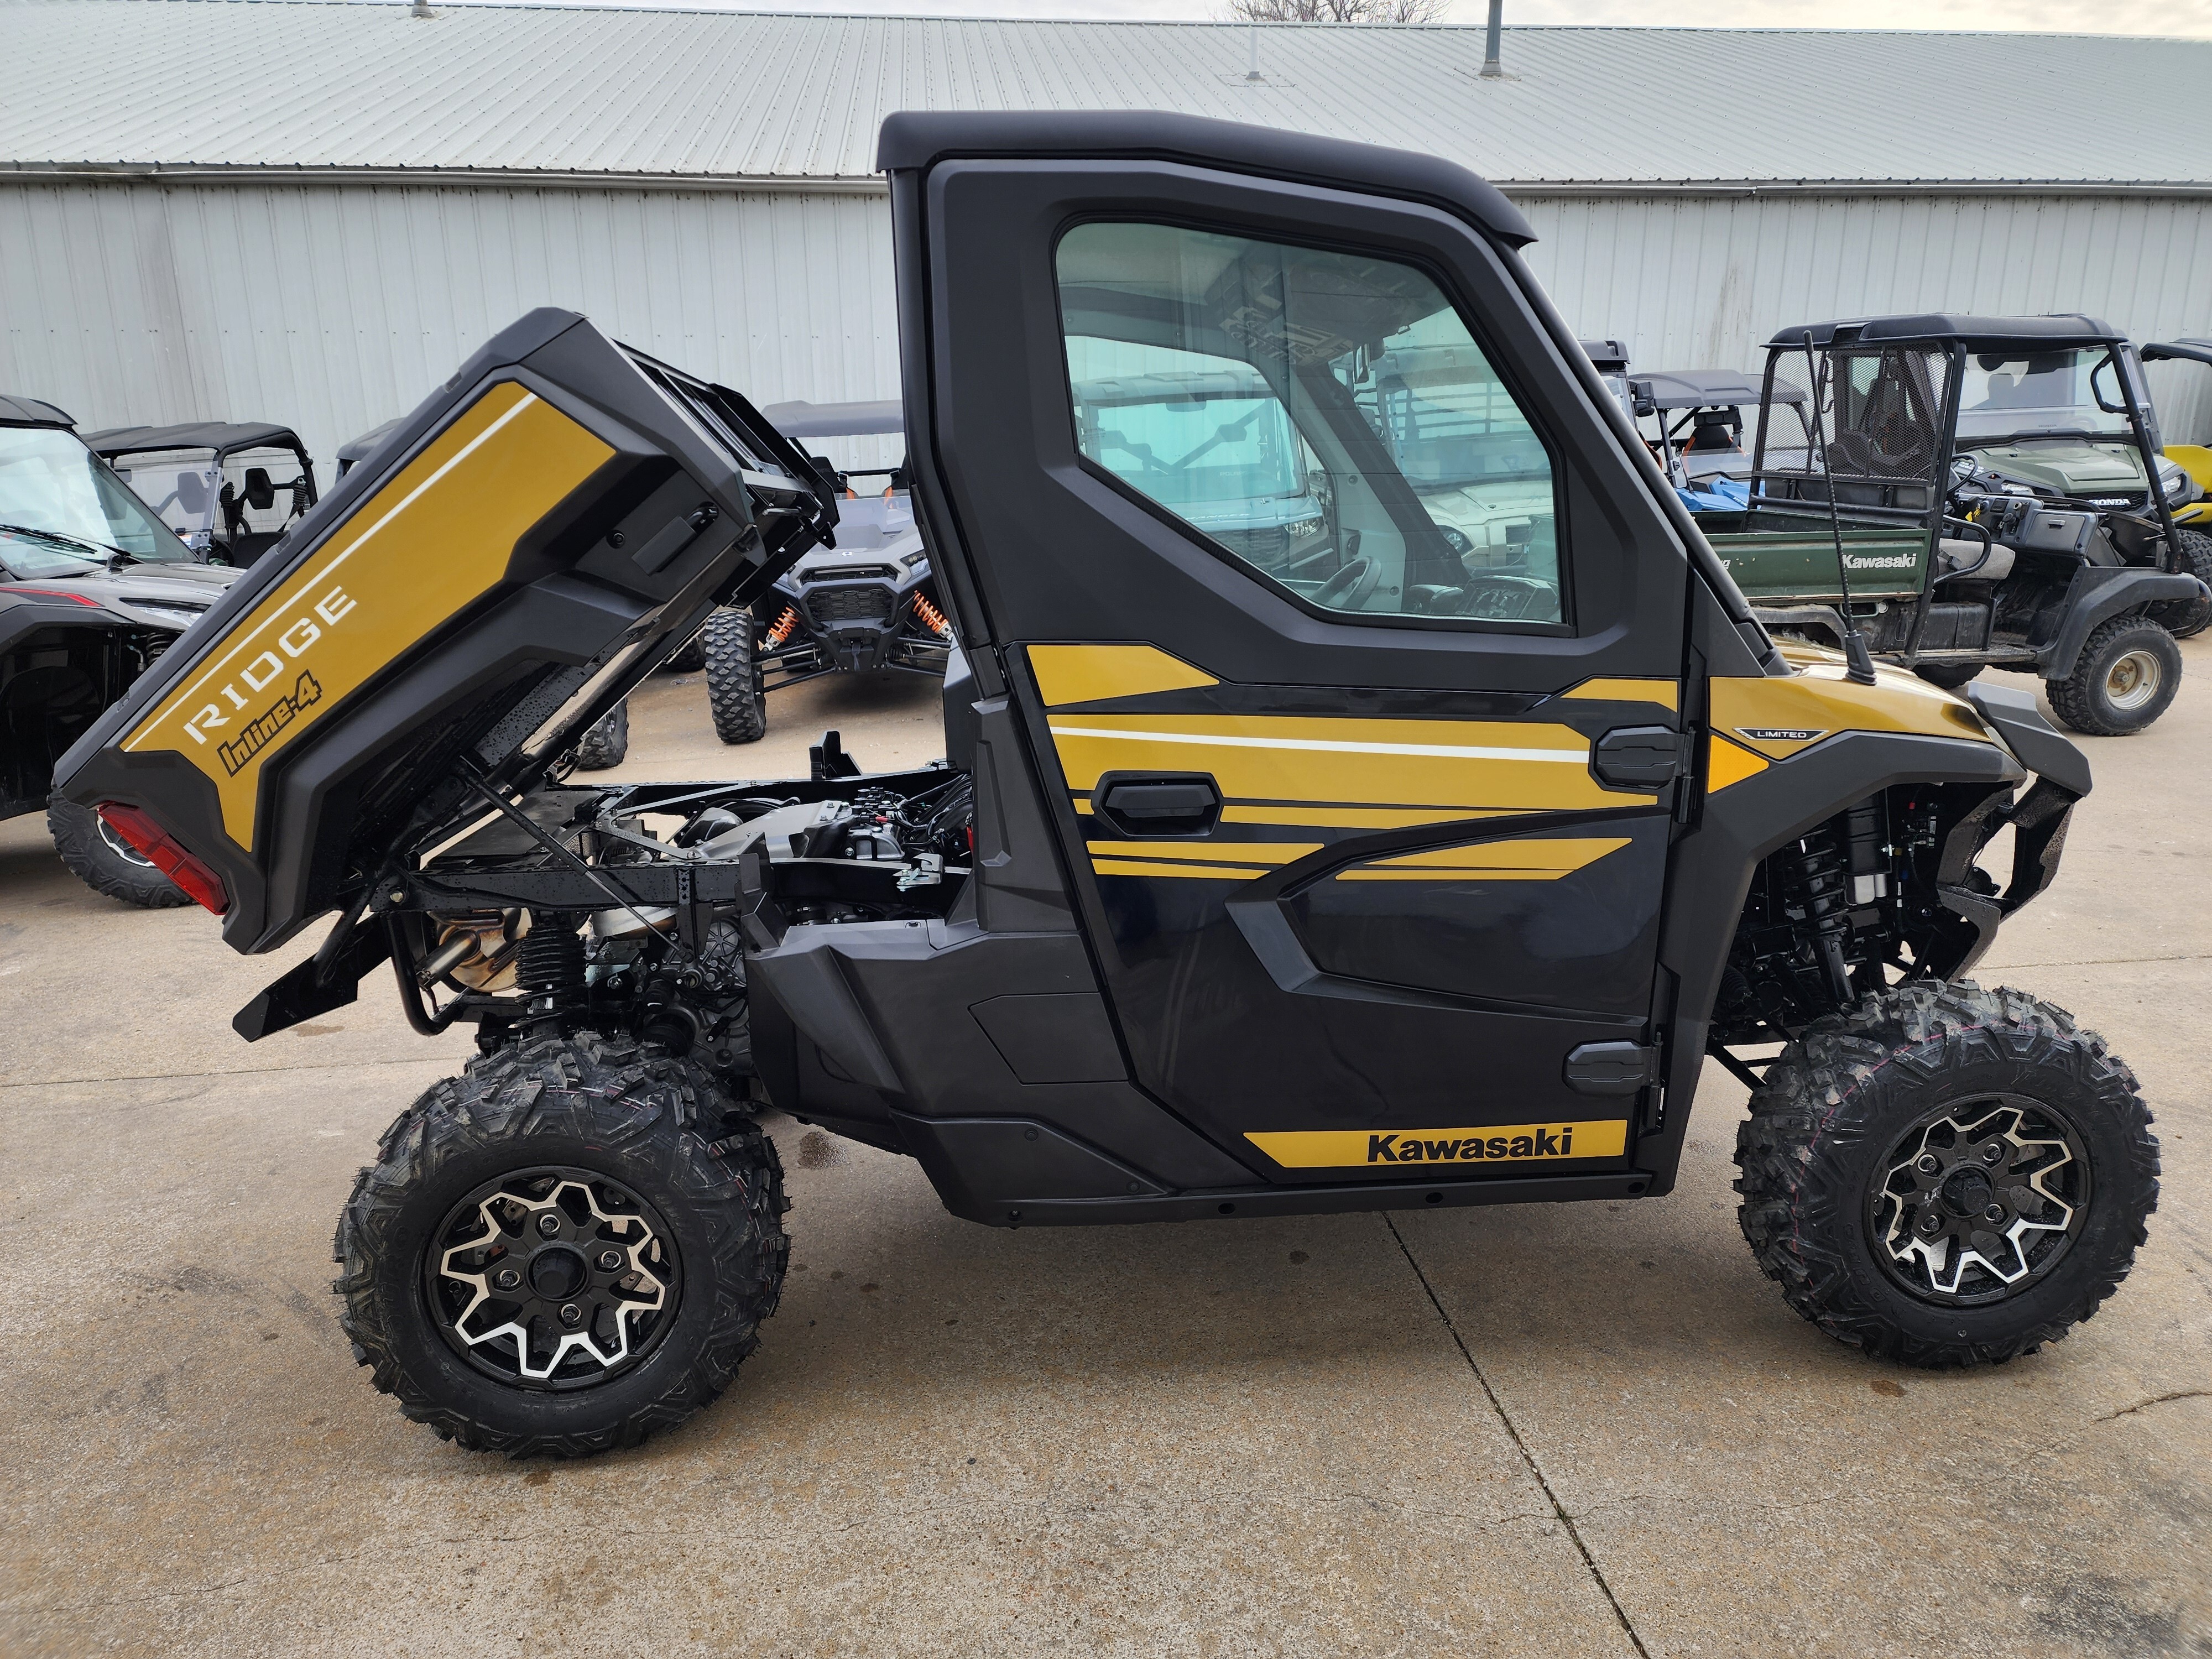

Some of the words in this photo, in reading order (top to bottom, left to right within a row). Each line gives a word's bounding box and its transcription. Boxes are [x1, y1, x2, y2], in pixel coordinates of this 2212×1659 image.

[1842, 553, 1917, 568] Kawasaki
[183, 586, 357, 745] RIDGE
[217, 669, 322, 778] Inline-4
[1368, 1127, 1573, 1162] Kawasaki
